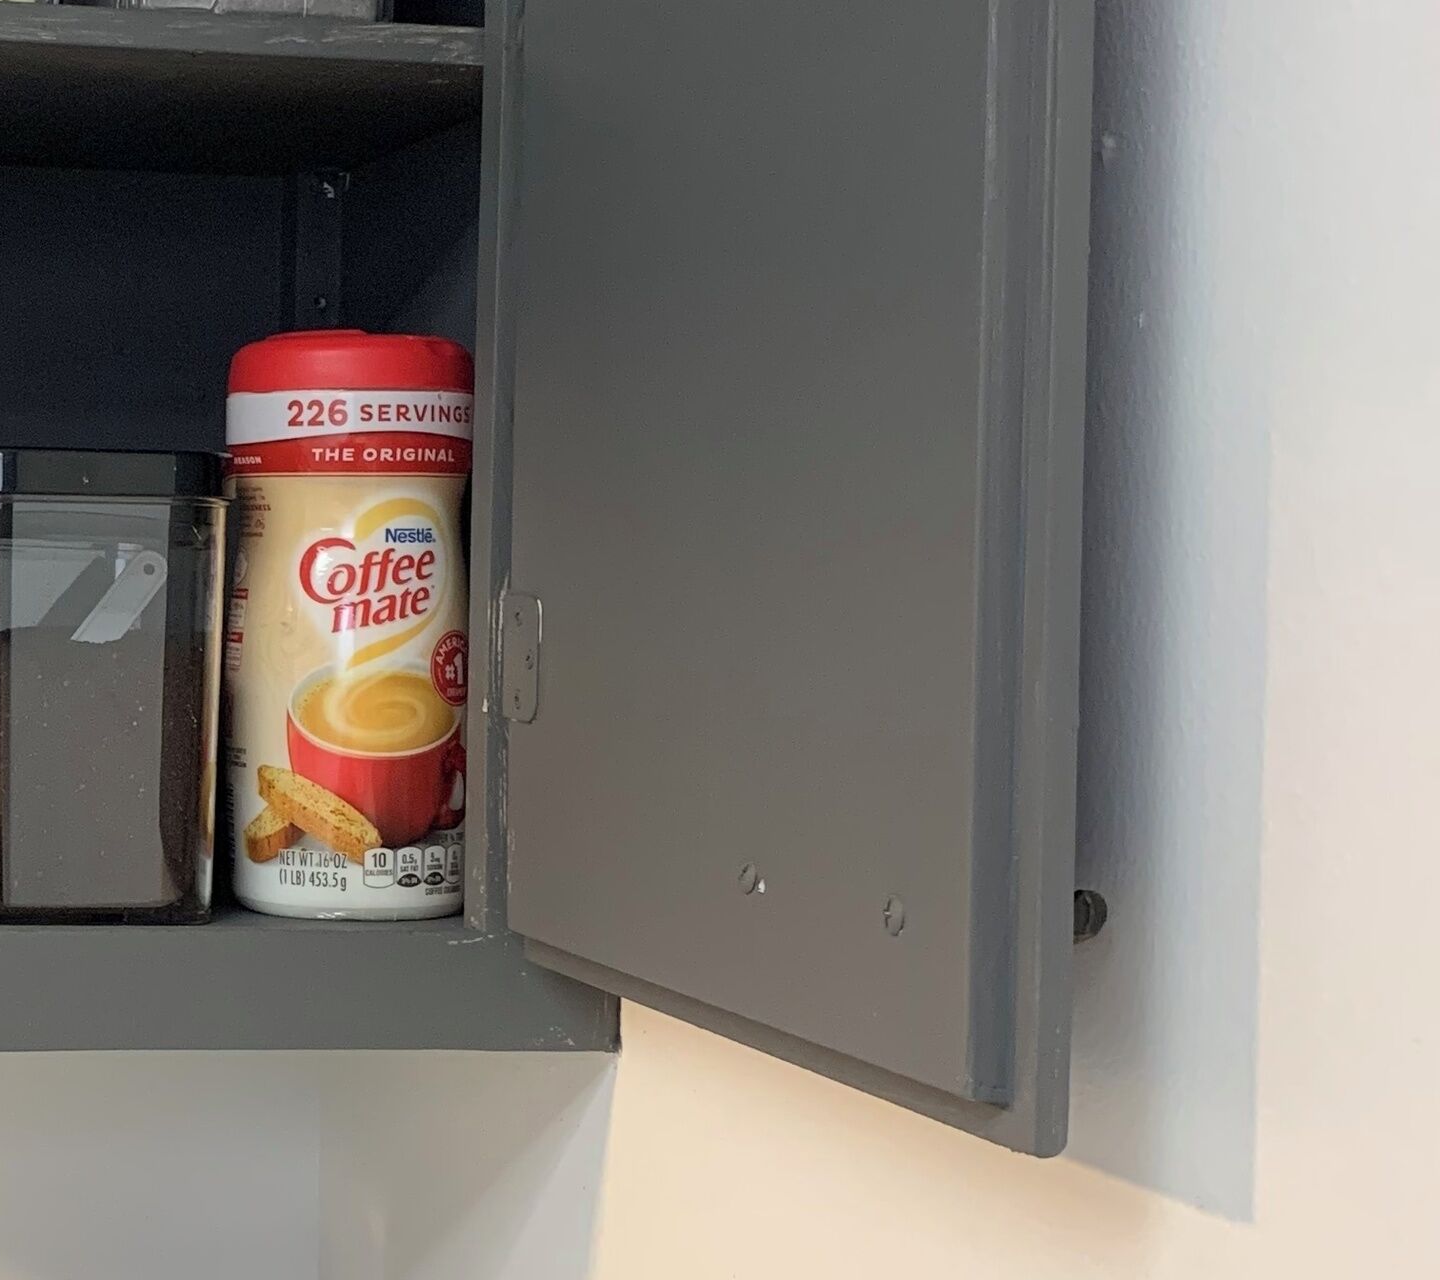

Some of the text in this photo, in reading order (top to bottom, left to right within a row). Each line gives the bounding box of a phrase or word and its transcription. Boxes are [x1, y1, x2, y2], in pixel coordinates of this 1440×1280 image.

[287, 399, 471, 427] 226 SERVINGS
[312, 448, 455, 463] THE ORIGINAL
[299, 537, 435, 604] Coffee
[331, 587, 430, 633] mate
[279, 851, 347, 868] NET WT 16 OZ
[372, 852, 386, 868] 10
[279, 868, 287, 885] (1
[291, 870, 305, 887] LB)
